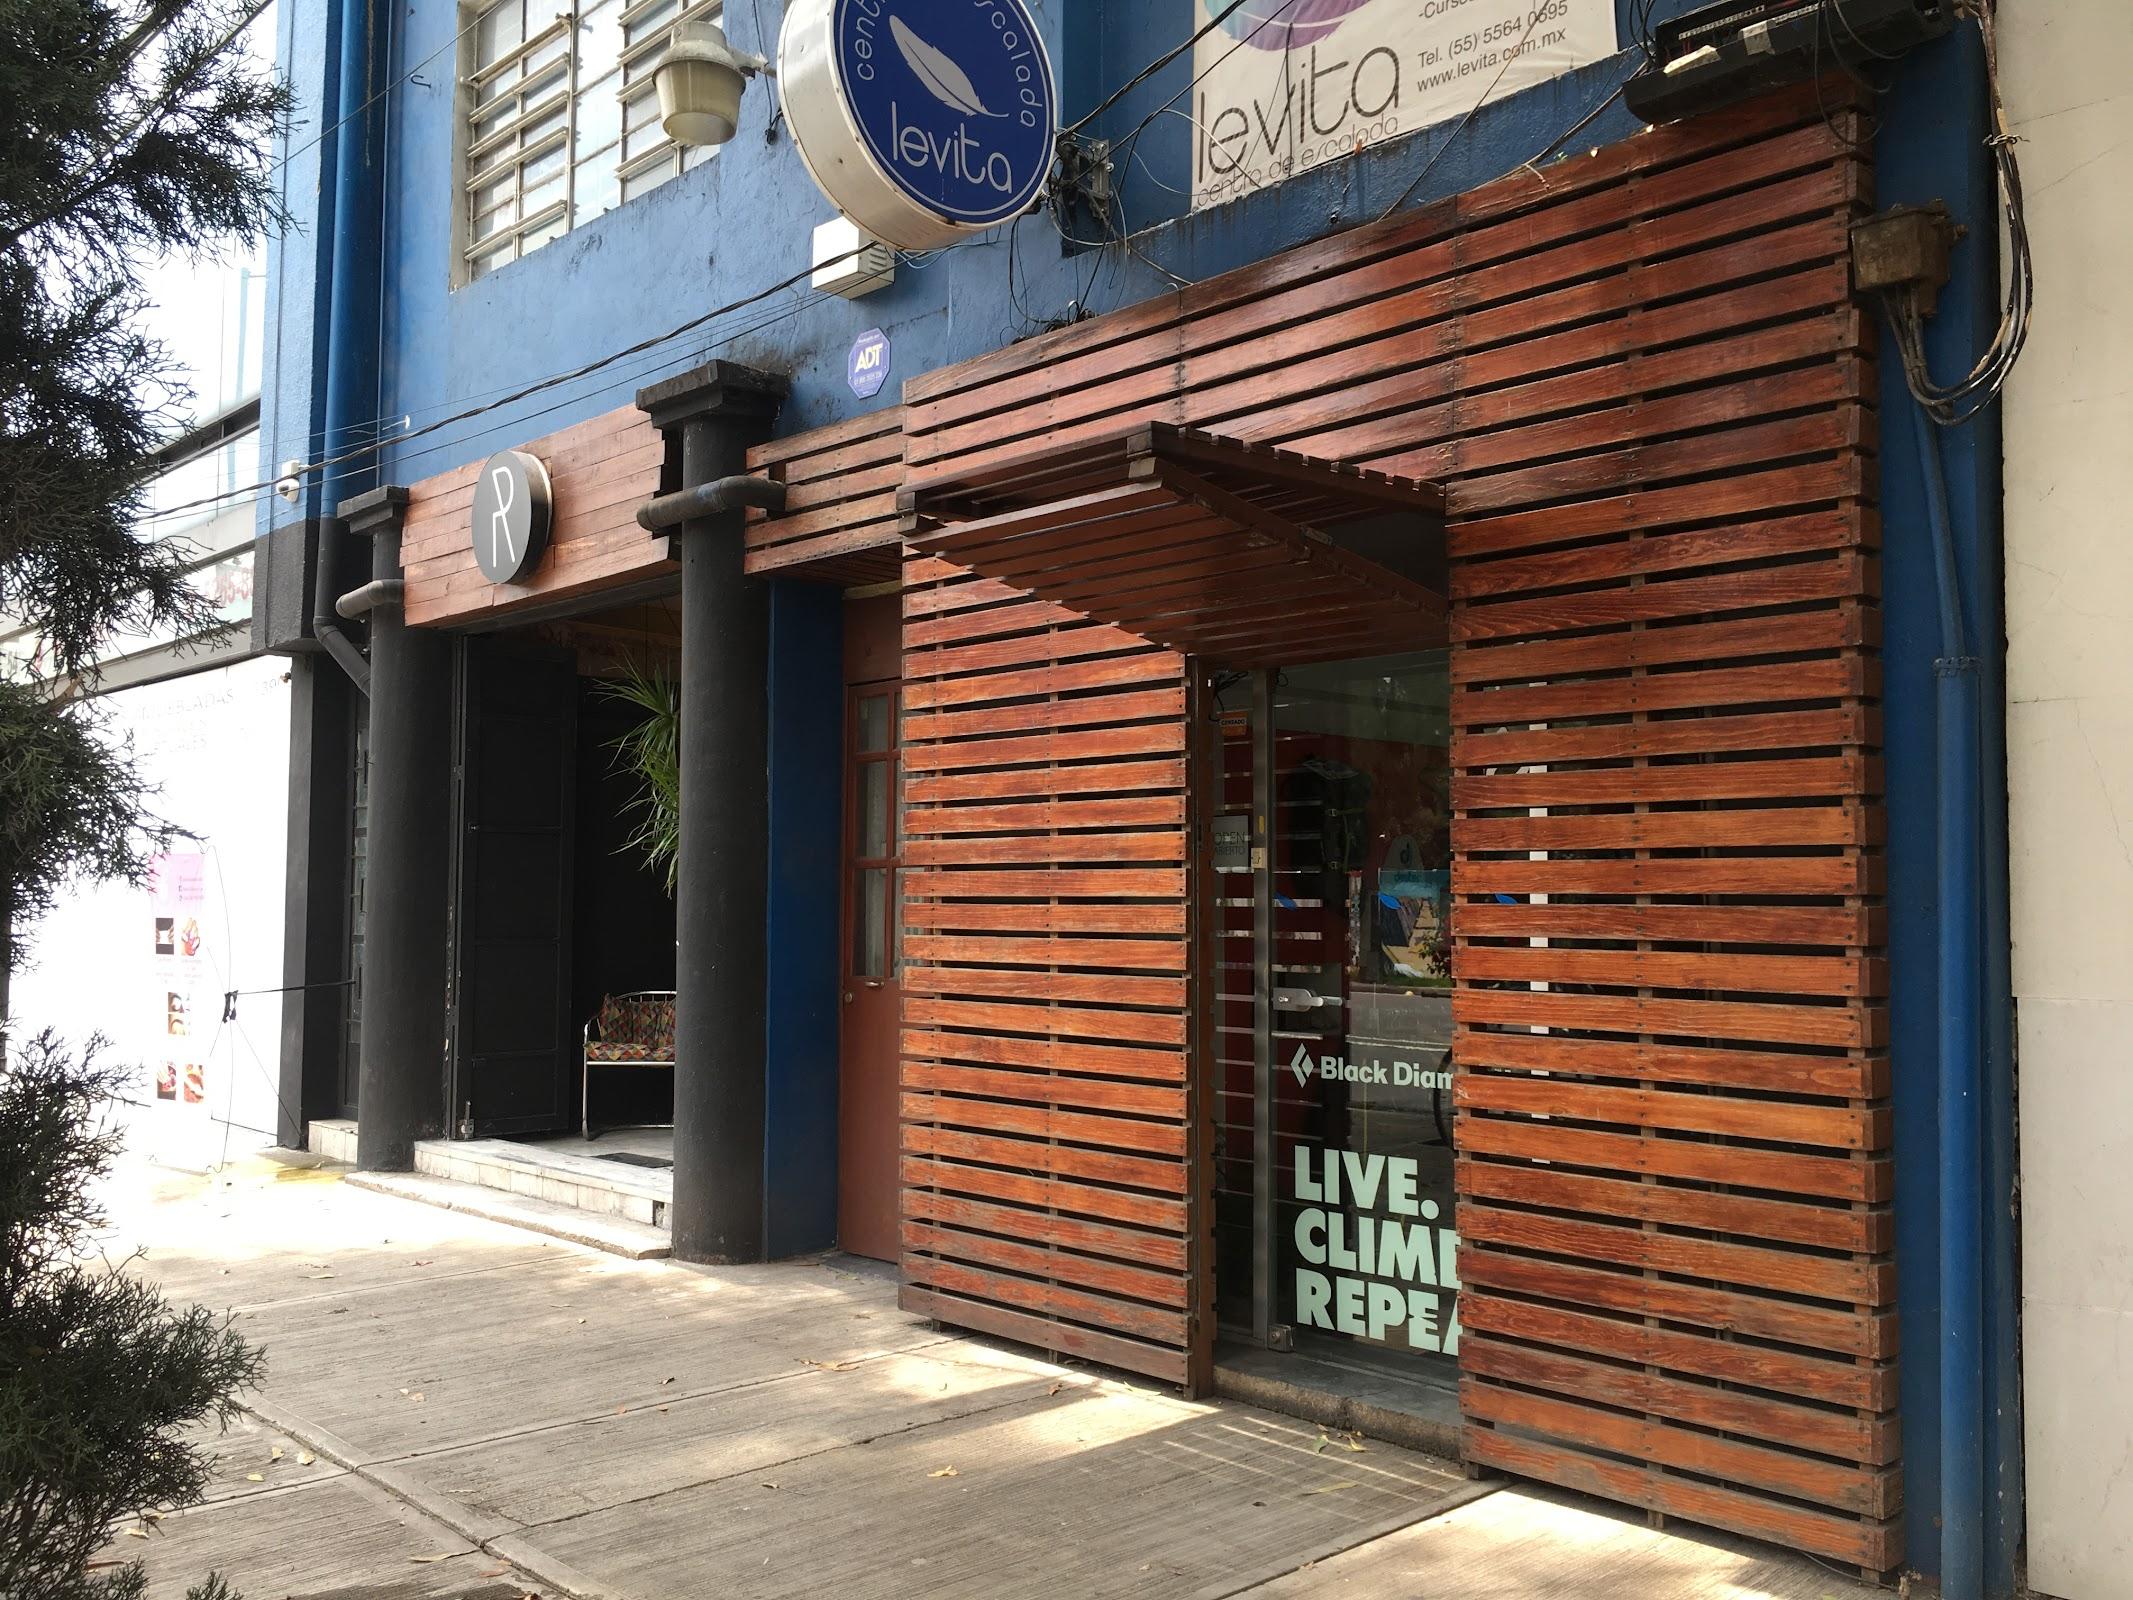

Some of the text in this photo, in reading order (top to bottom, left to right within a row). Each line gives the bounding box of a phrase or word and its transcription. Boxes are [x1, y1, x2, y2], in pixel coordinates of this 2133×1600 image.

[855, 0, 1043, 128] cent scalada
[1417, 27, 1567, 92] www.levita.com.mx
[1418, 47, 1443, 69] Tel.
[1449, 33, 1478, 60] (55)
[1483, 16, 1522, 44] 5564
[892, 101, 1013, 194] levita
[1198, 45, 1400, 184] levita
[1197, 112, 1399, 206] centro de escalada
[855, 343, 884, 374] ADT
[492, 466, 516, 568] R
[1214, 831, 1246, 846] OPEN
[1320, 1056, 1389, 1085] Black
[1294, 1145, 1440, 1220] LIVE.
